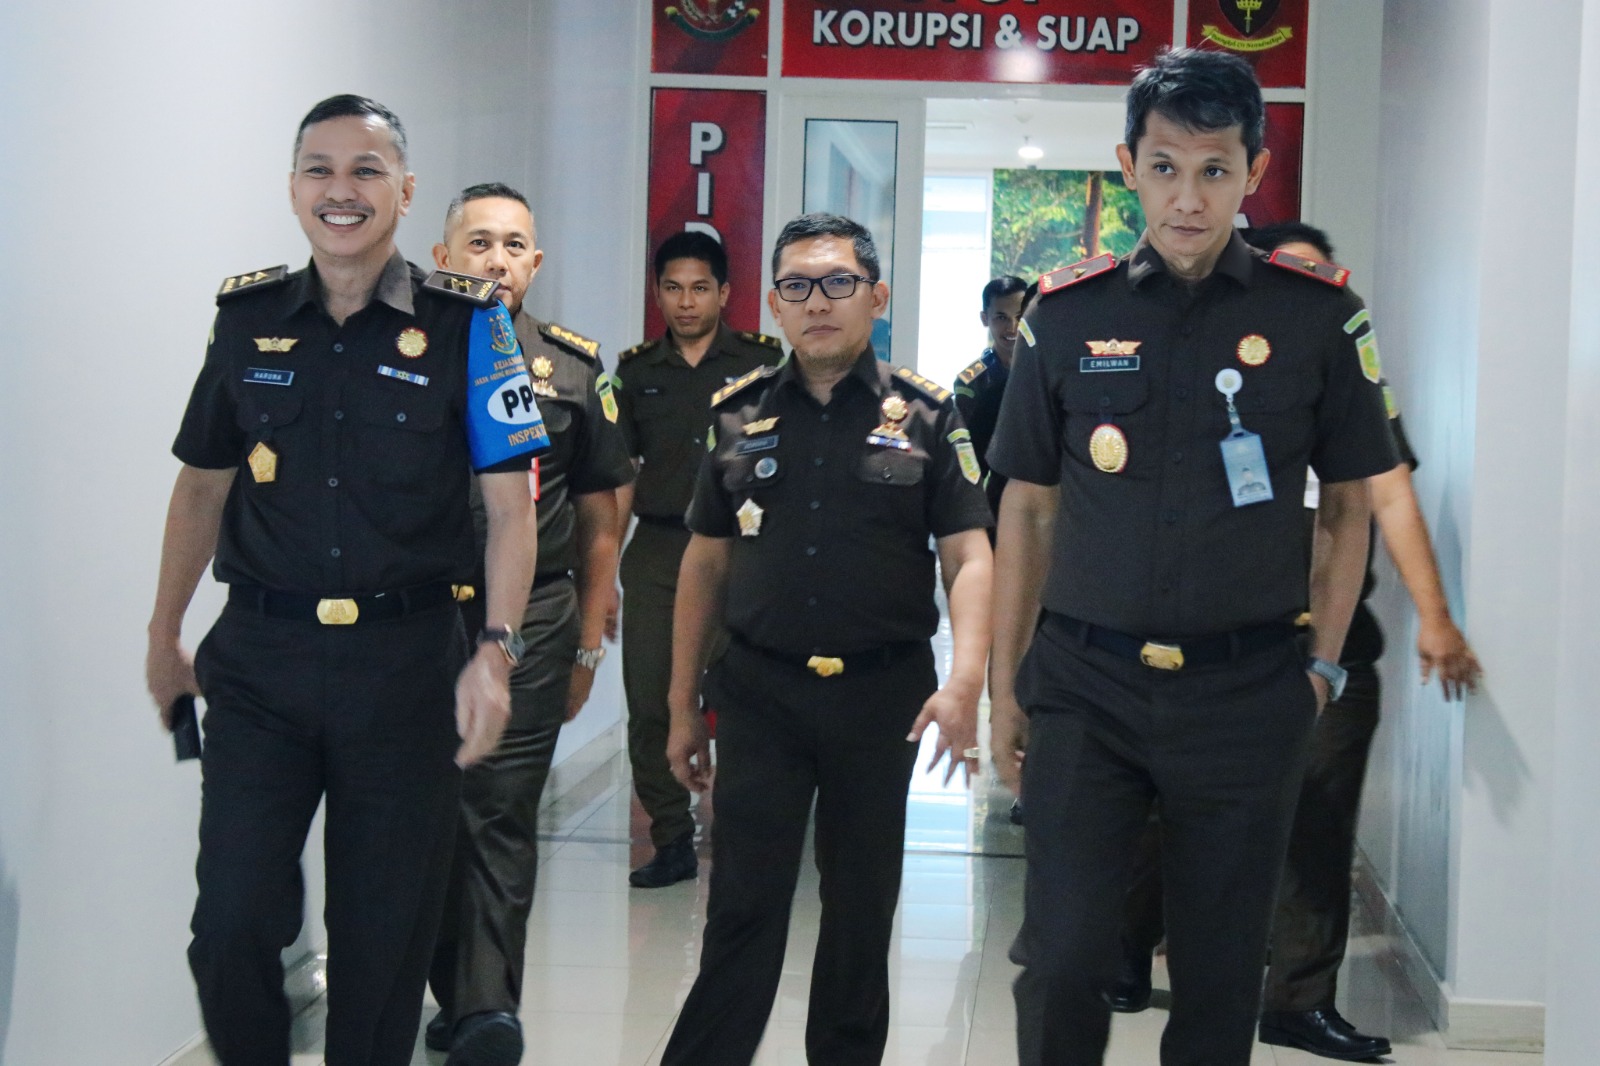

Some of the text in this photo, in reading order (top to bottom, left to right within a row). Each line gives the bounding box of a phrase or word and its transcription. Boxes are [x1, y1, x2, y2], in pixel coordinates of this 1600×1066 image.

[812, 10, 1140, 52] KORUPSI & SUAP
[1090, 359, 1129, 368] EMILWAN
